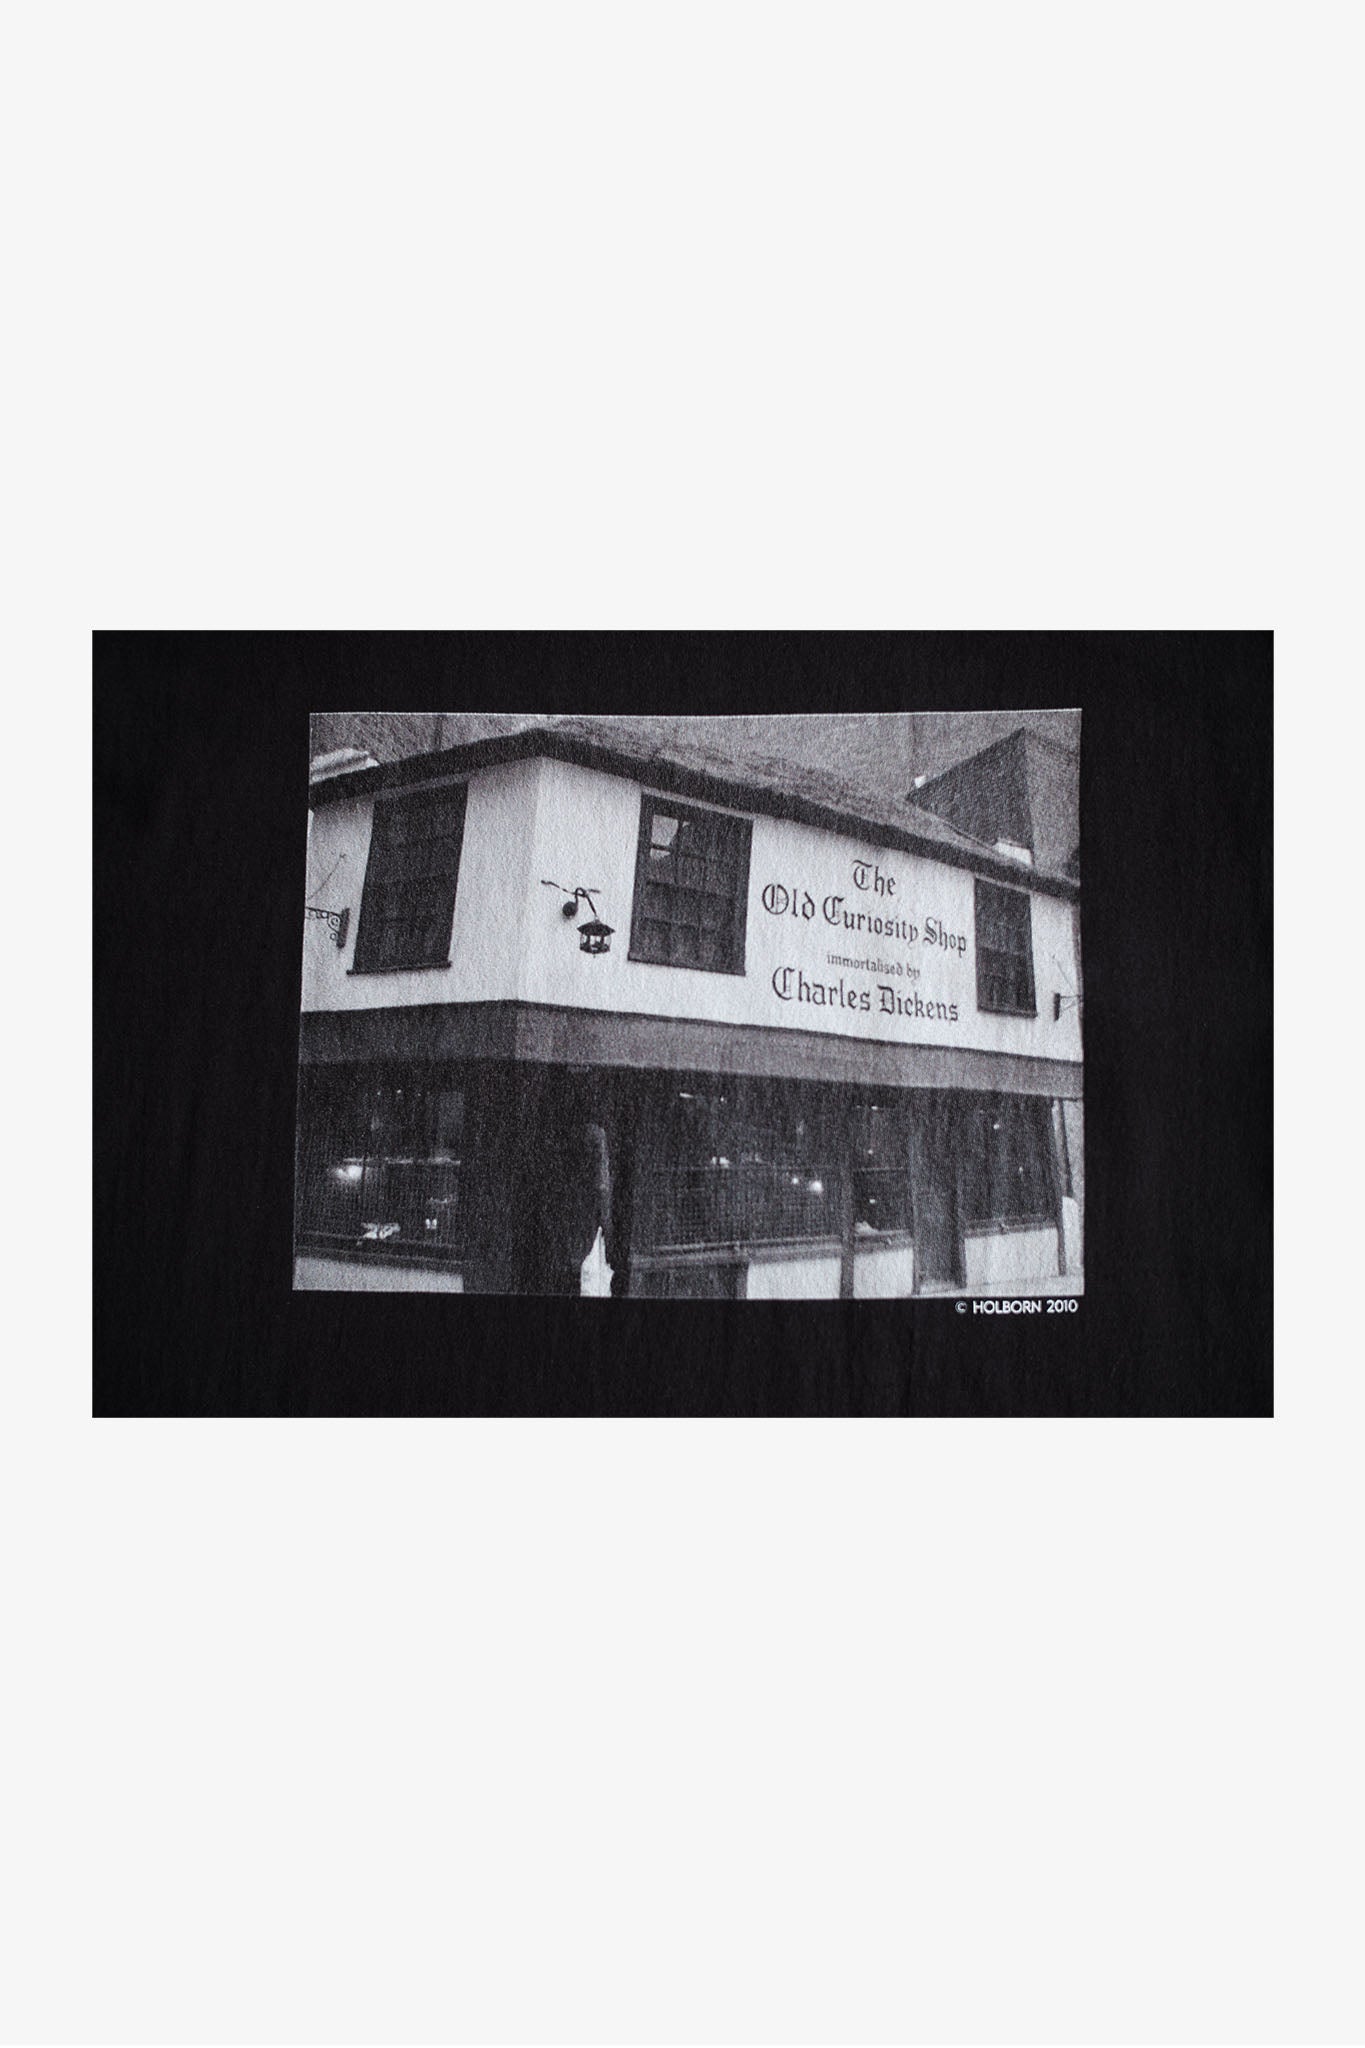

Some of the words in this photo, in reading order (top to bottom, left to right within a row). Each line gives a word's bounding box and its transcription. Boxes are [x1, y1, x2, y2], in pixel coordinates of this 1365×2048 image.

[852, 859, 897, 897] The
[761, 883, 816, 920] Old
[822, 895, 919, 947] Curiosity
[923, 916, 967, 958] Shop
[826, 954, 904, 977] immortalised
[906, 965, 921, 982] by
[771, 966, 871, 1012] Charles
[877, 984, 960, 1022] Dickens
[972, 1300, 1041, 1314] HOLBORN
[1046, 1299, 1079, 1313] 2010
